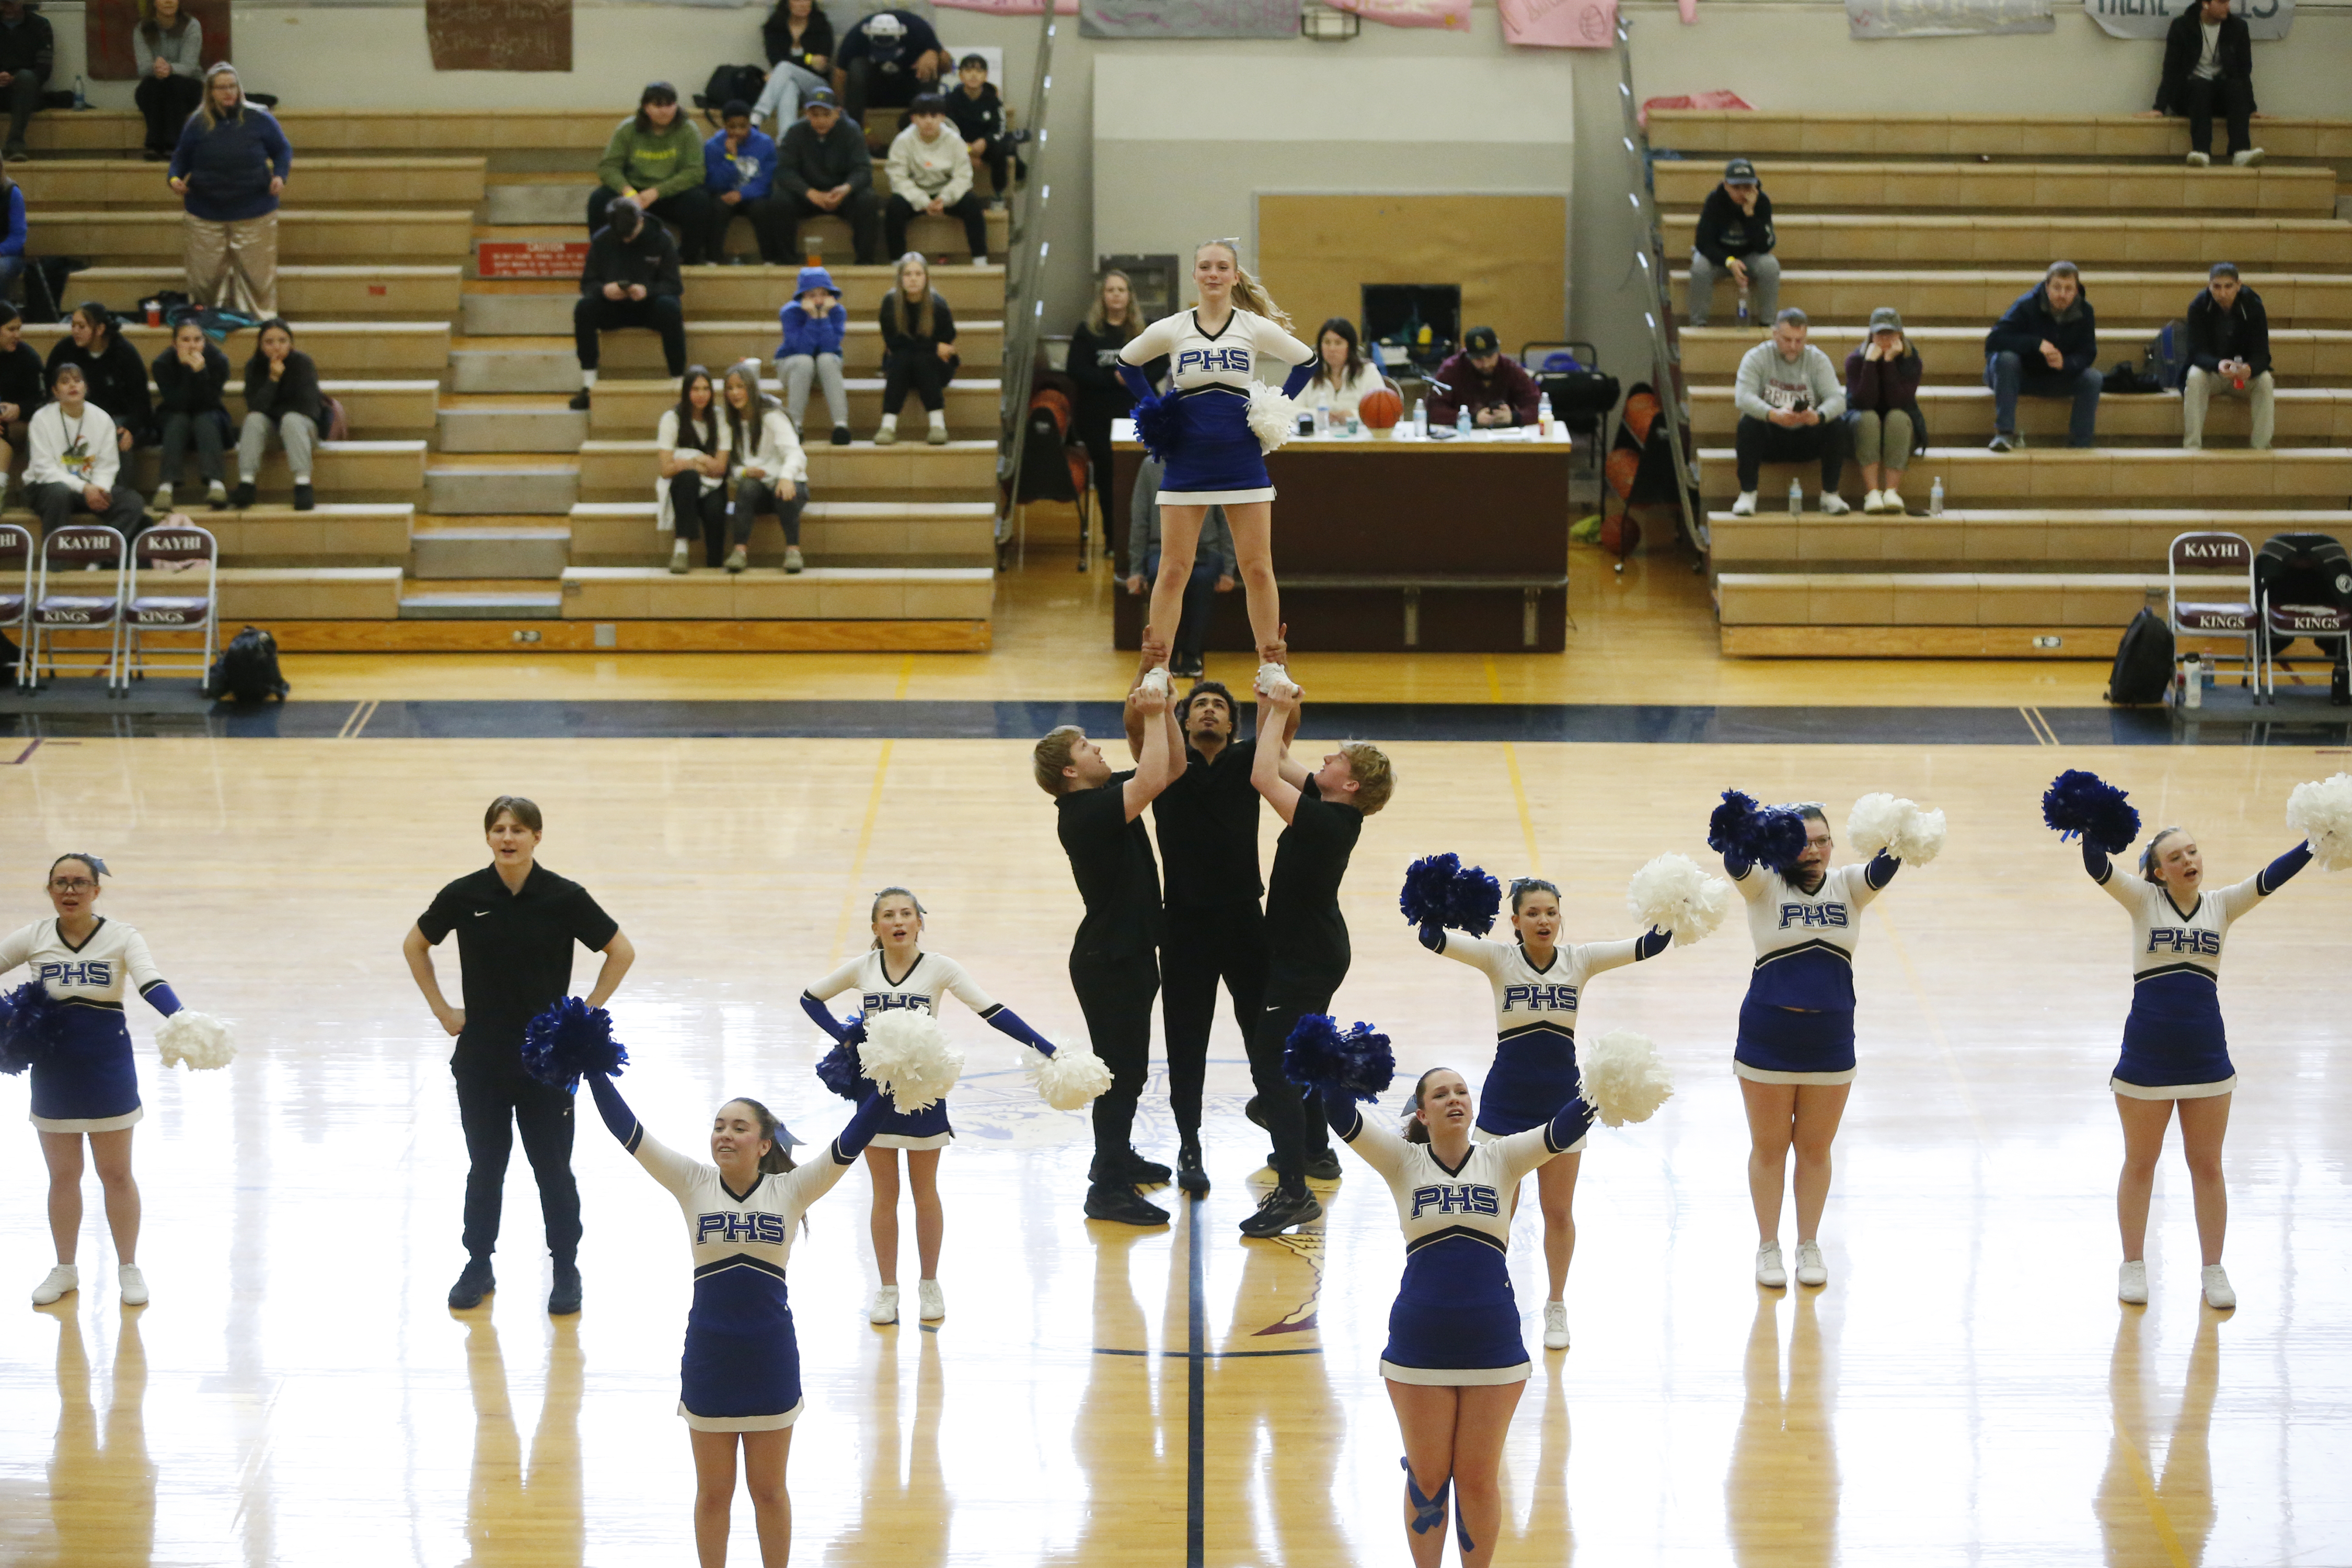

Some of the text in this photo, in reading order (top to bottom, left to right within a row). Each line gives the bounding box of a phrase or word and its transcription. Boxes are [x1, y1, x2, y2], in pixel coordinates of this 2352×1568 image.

[1177, 347, 1250, 376] PHS
[57, 535, 111, 550] KAYHI
[147, 535, 201, 550] KAYHI
[2184, 543, 2240, 557] KAYHI
[43, 610, 90, 622] KINGS
[137, 610, 185, 623] KINGS
[2199, 615, 2245, 628] KINGS
[2294, 617, 2340, 629] KINGS
[1779, 902, 1849, 930] PHS
[2147, 927, 2220, 957] PHS
[40, 960, 113, 987] PHS
[1503, 984, 1578, 1012] PHS
[1411, 1184, 1500, 1220] PHS
[696, 1211, 786, 1245] PHS
